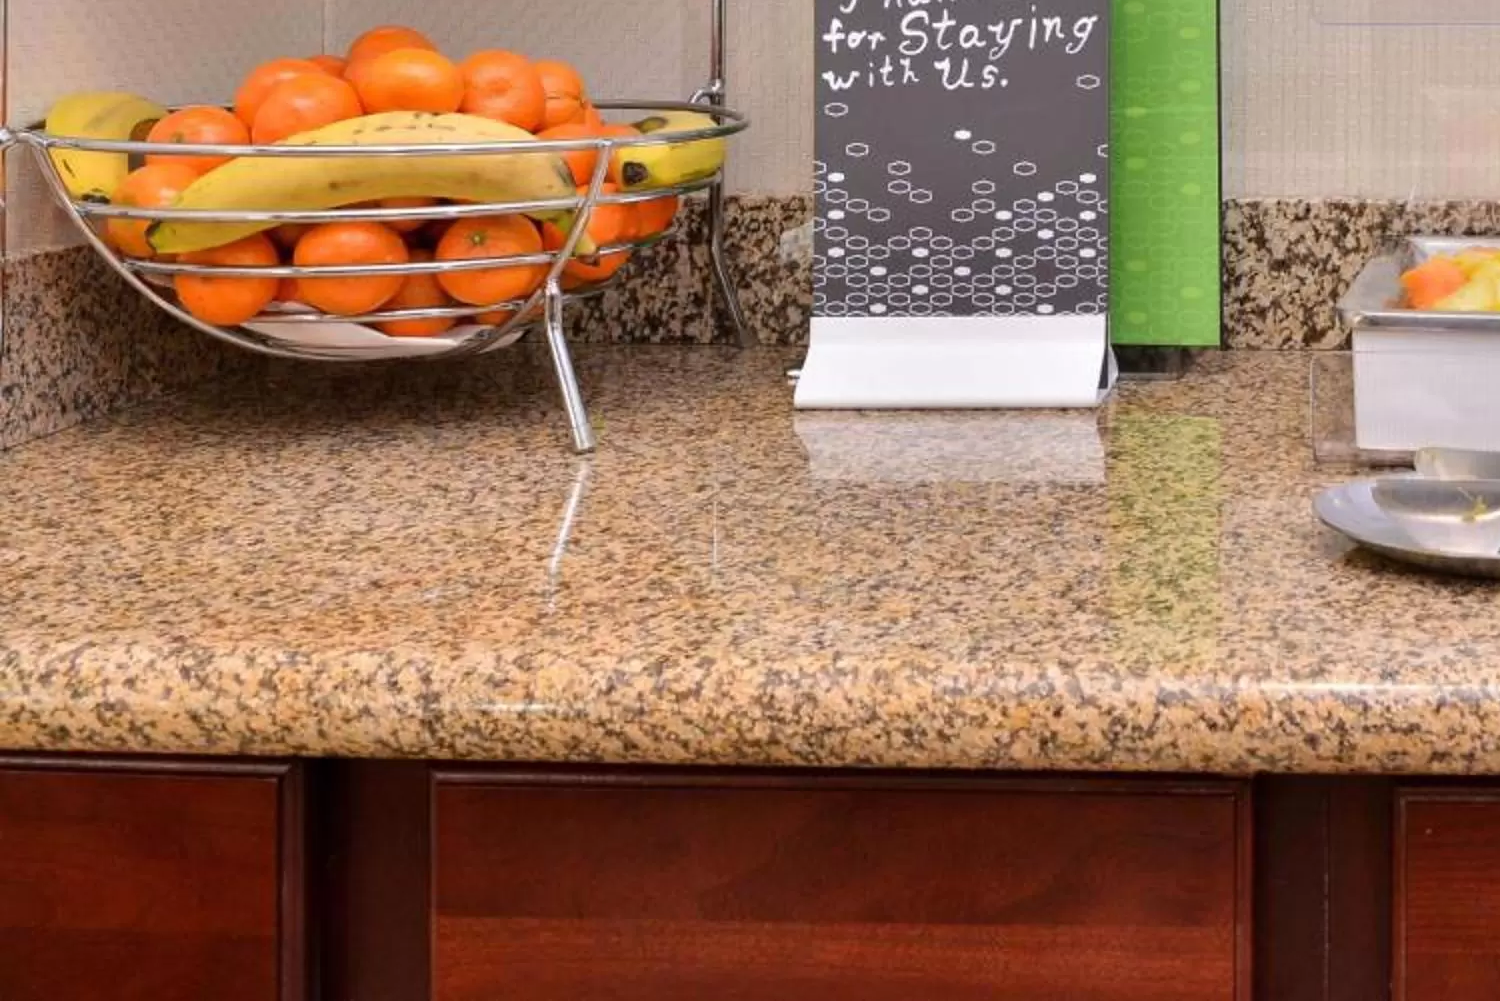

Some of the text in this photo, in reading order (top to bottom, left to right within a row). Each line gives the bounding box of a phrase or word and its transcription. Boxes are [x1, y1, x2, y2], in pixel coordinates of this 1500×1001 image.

[821, 4, 1099, 61] for Staying
[821, 54, 1009, 91] with Us.
